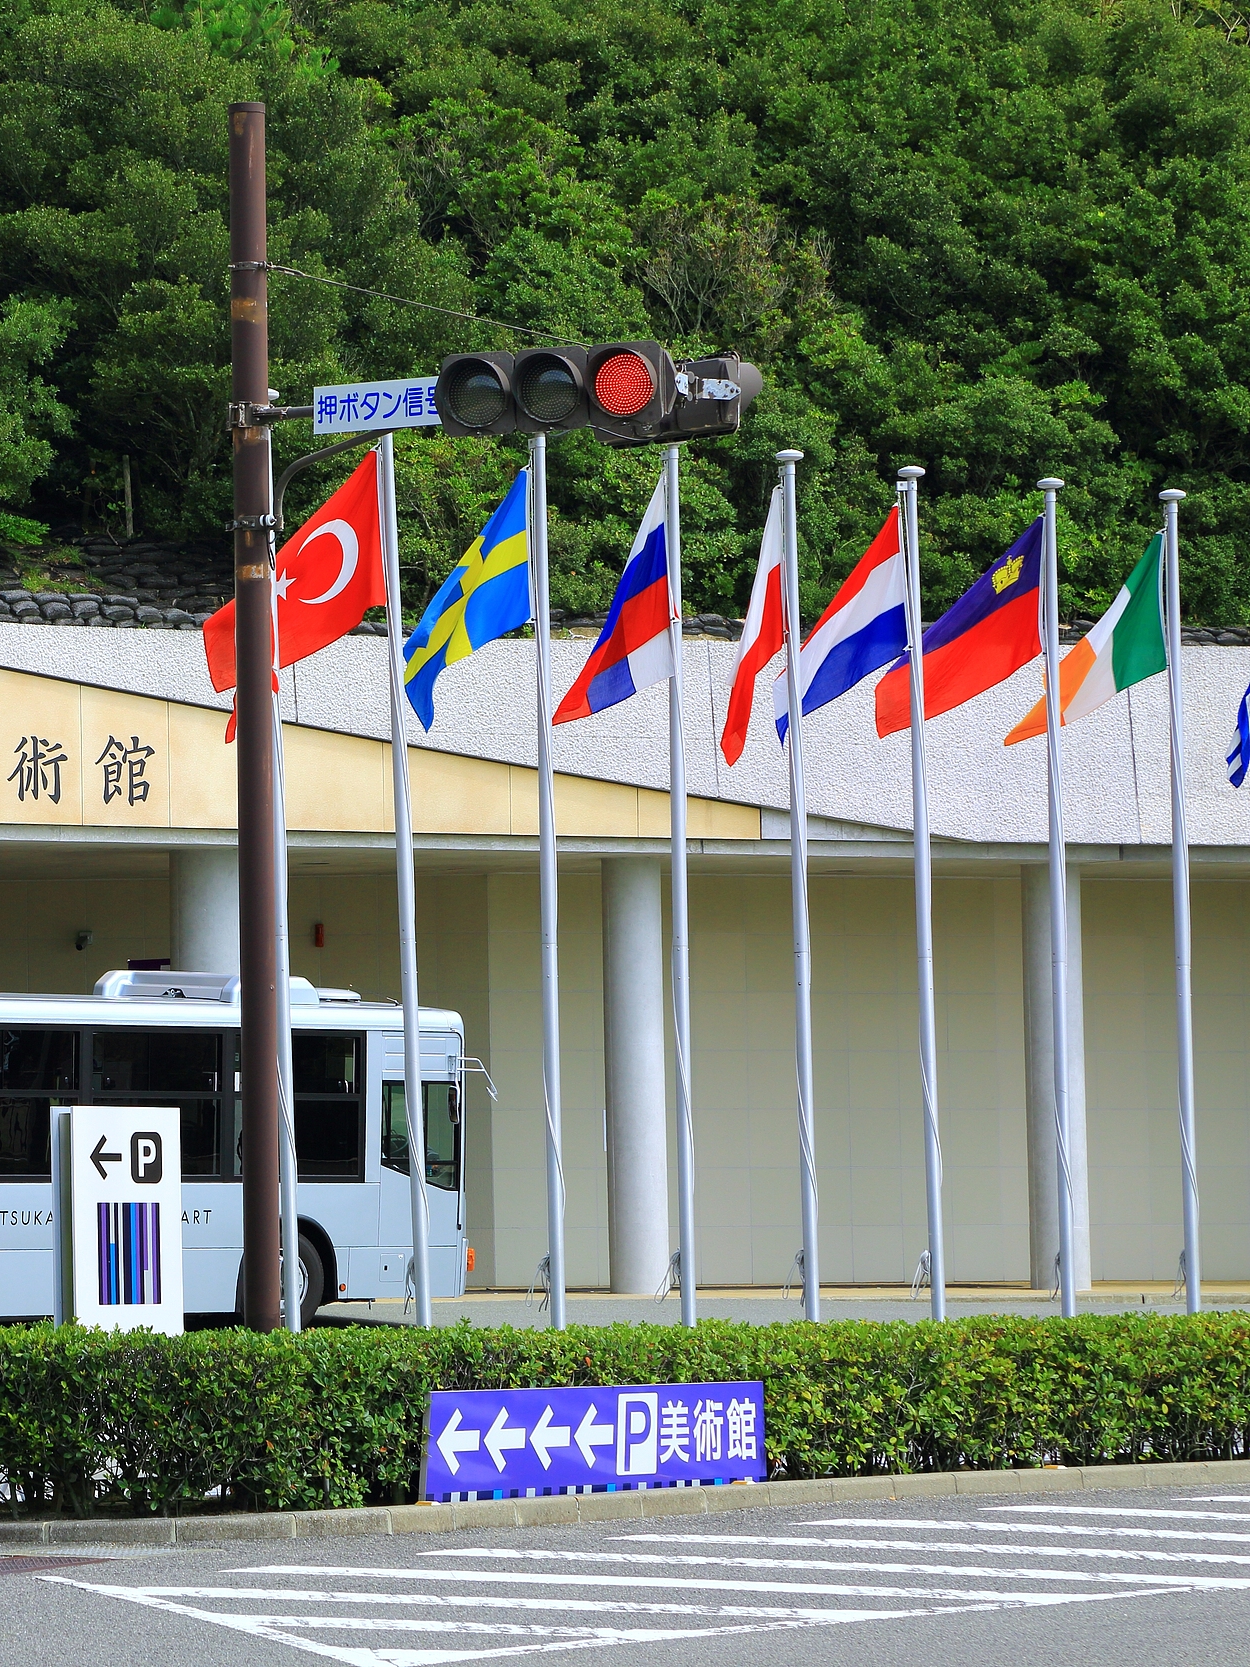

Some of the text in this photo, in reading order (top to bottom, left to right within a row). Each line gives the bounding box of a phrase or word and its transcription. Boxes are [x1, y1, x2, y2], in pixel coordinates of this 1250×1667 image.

[137, 1138, 157, 1177] P
[181, 1209, 212, 1224] ART
[624, 1397, 757, 1472] P 美術館
